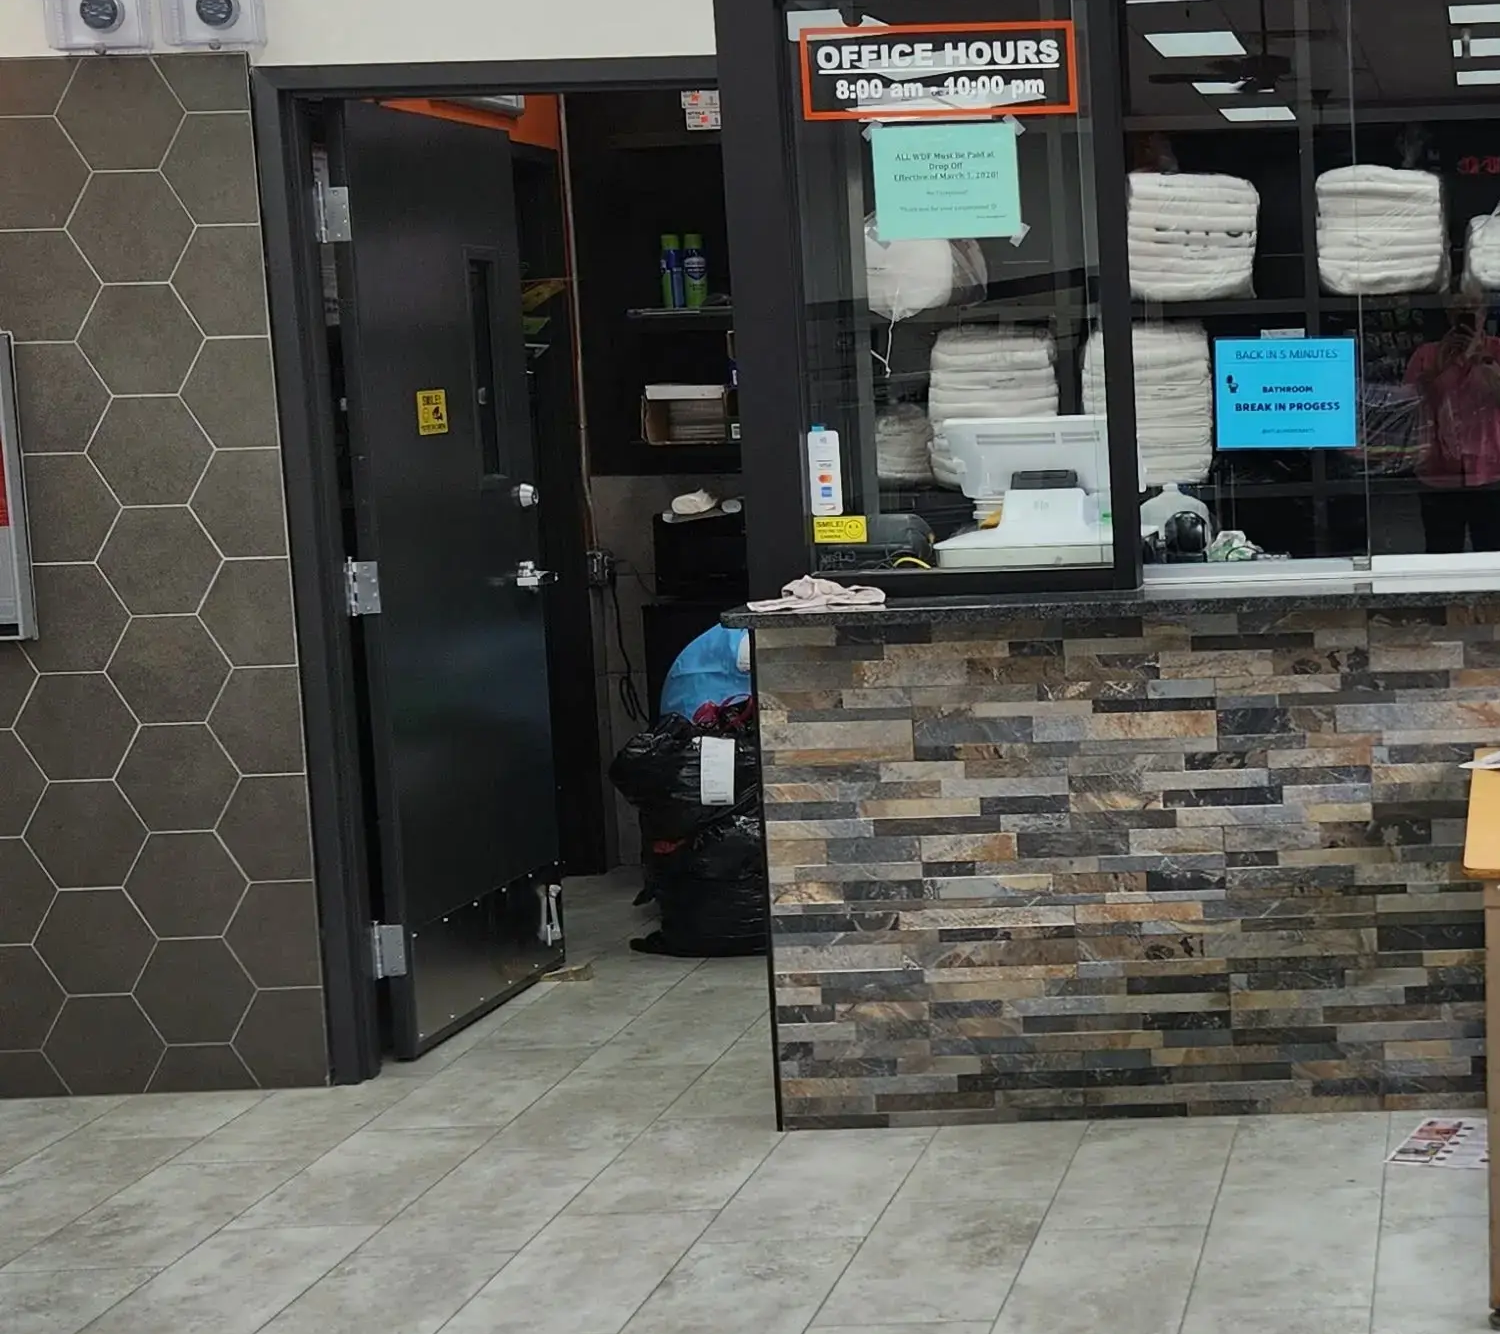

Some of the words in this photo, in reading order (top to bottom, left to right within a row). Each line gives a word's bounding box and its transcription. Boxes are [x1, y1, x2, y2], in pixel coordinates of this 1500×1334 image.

[816, 43, 934, 69] OFFICE
[944, 39, 1060, 65] HOURS
[835, 78, 883, 99] 8:00
[890, 80, 924, 98] am
[943, 75, 1004, 96] 10:00
[1011, 78, 1045, 98] pm
[928, 163, 948, 171] Drop
[951, 162, 963, 170] Off
[1235, 350, 1263, 360] BACK
[1266, 350, 1277, 359] IN
[1289, 349, 1337, 359] MINUTES
[1235, 403, 1272, 412] BREAK
[1275, 402, 1286, 411] IN
[1289, 401, 1340, 411] PROGESS
